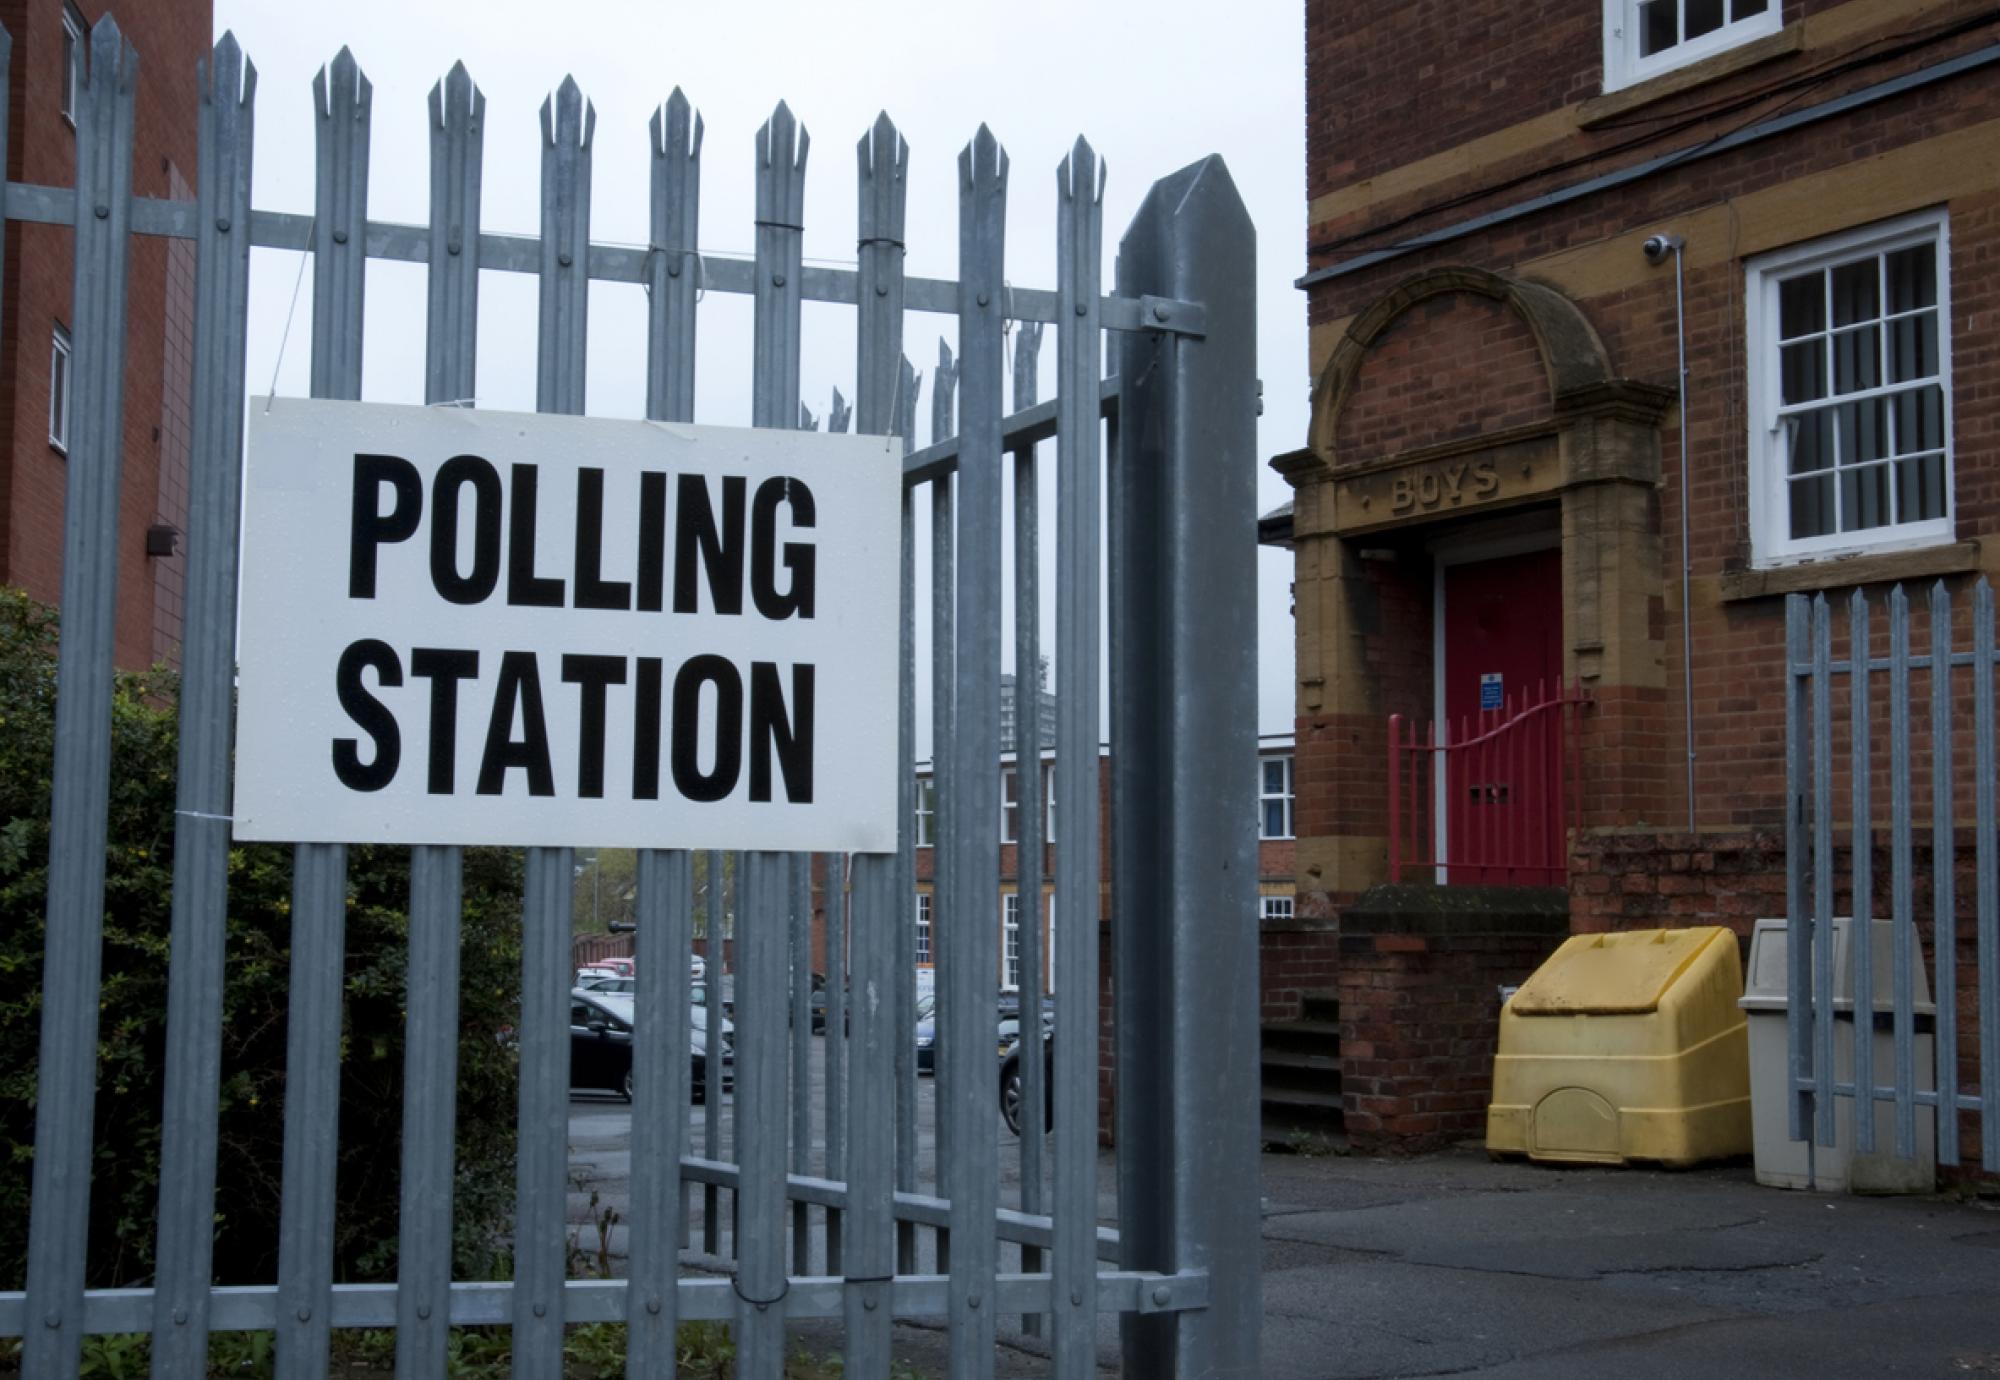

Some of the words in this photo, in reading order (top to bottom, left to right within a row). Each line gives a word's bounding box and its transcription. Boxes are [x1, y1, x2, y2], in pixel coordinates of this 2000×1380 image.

[349, 453, 816, 621] POLLING
[1393, 463, 1498, 515] BOYS
[332, 638, 815, 804] STATION
